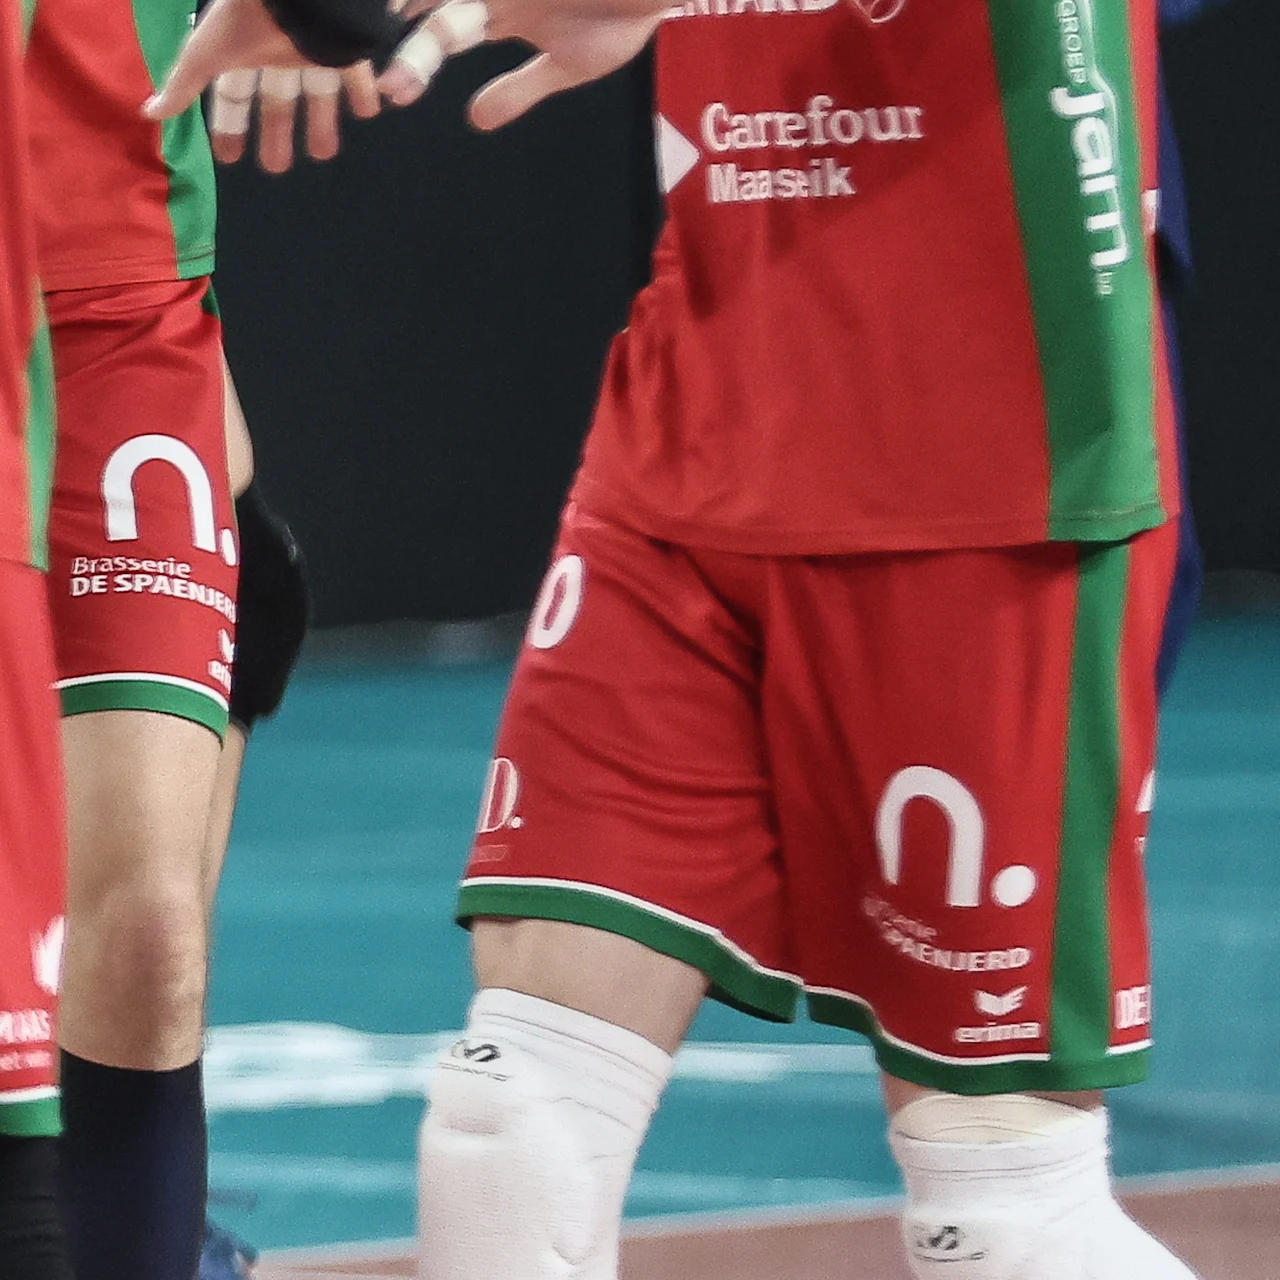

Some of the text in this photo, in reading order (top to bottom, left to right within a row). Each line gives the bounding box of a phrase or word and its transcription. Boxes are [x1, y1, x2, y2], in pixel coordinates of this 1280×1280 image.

[72, 557, 191, 579] Brasserie
[71, 574, 237, 625] DE SPAENJER
